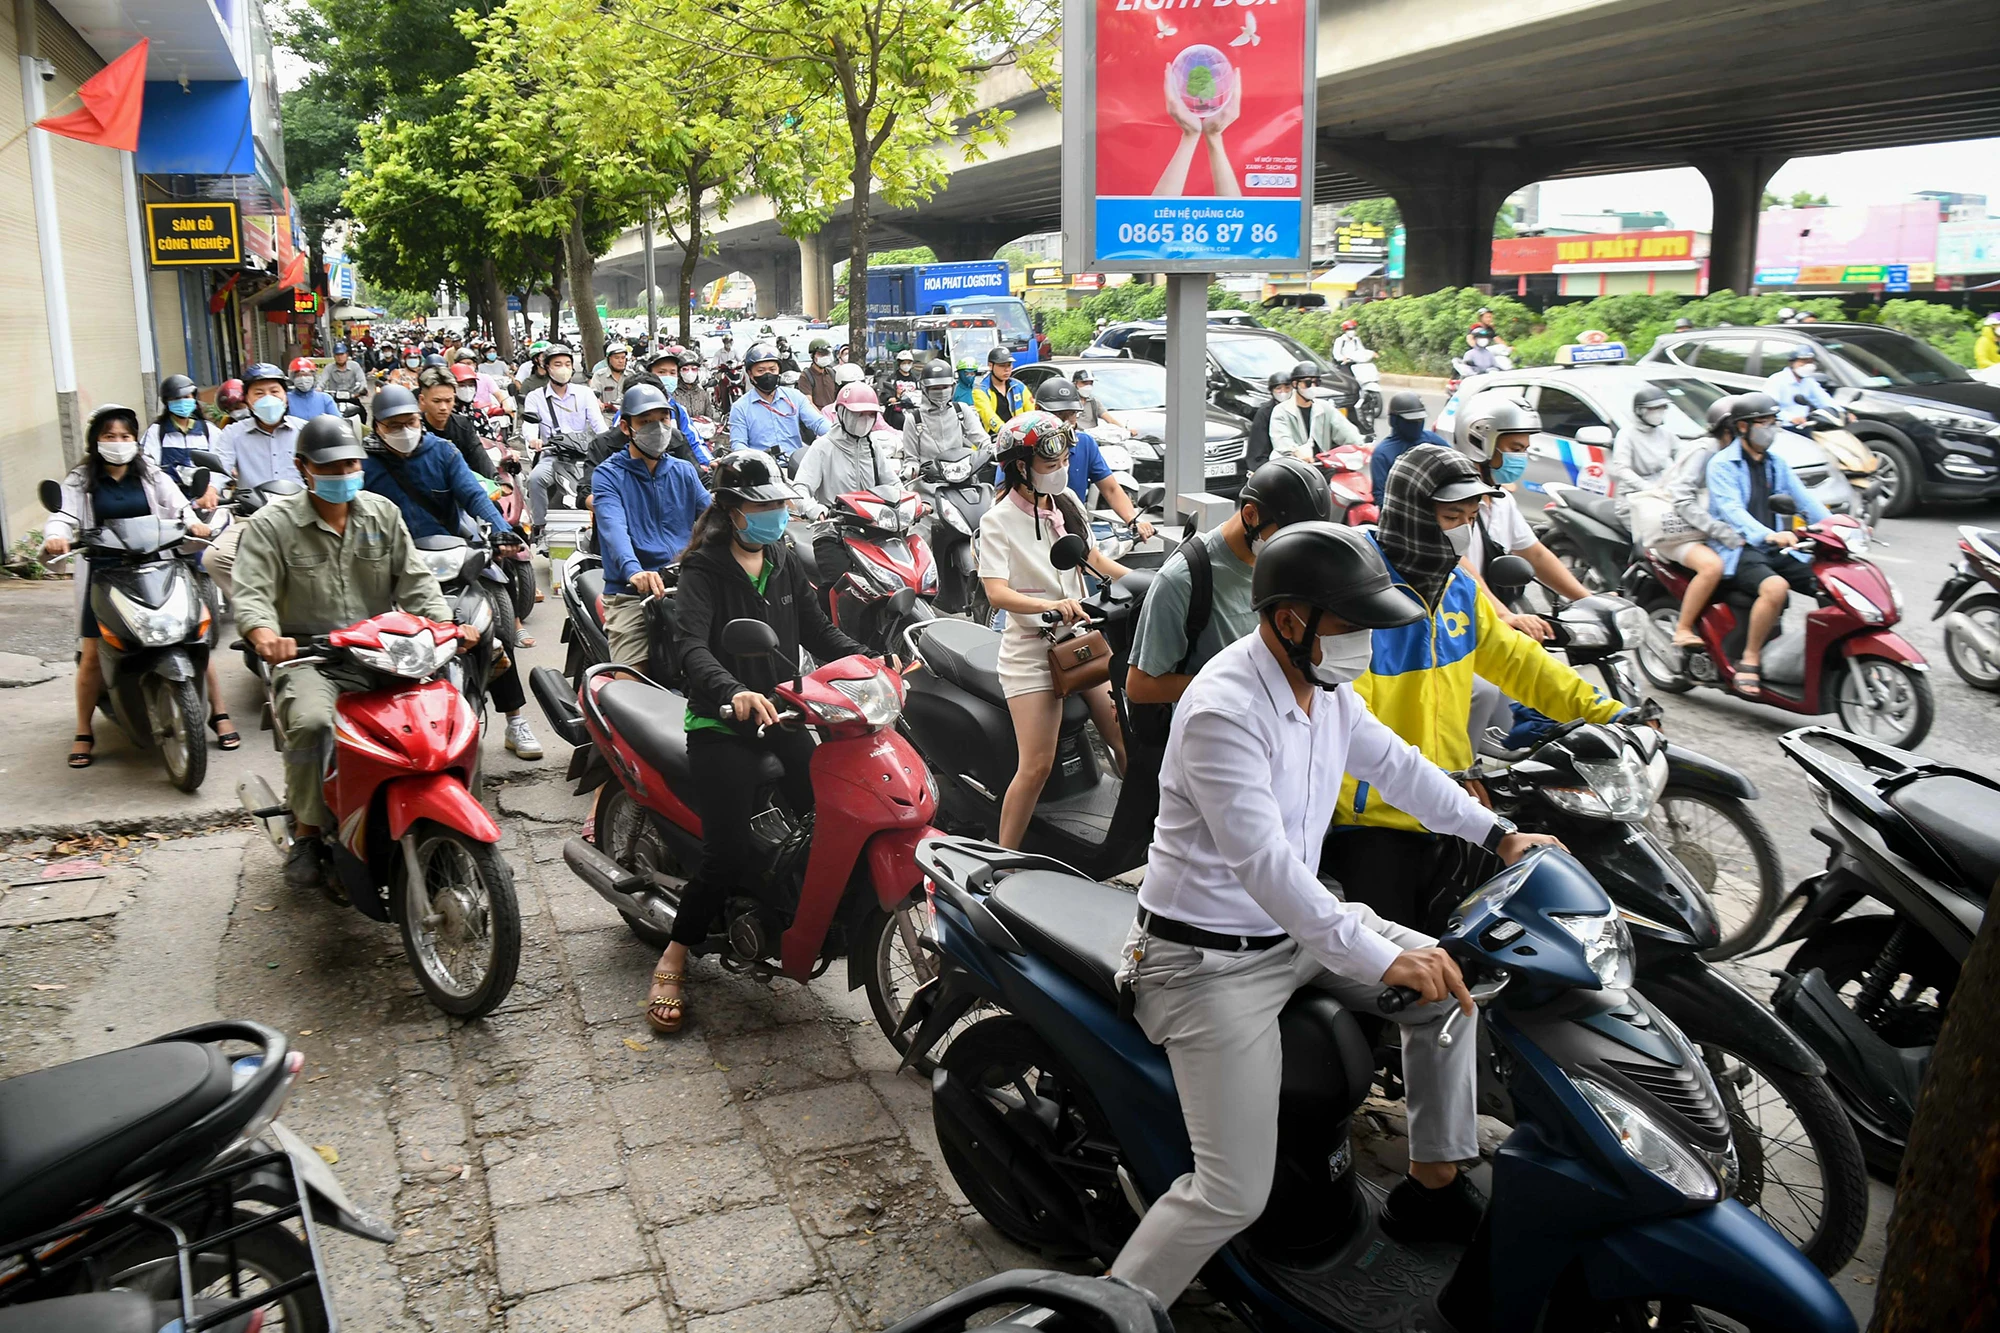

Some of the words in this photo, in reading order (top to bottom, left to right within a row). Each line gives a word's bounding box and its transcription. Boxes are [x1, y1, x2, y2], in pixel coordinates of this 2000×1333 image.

[1154, 207, 1176, 219] LIÊN
[1177, 207, 1190, 220] HỆ
[1225, 207, 1244, 219] CÁO
[172, 216, 197, 231] SÀN
[1118, 223, 1174, 244] 0865
[1181, 223, 1209, 243] 86
[1216, 223, 1244, 243] 87
[1251, 223, 1278, 243] 86
[157, 236, 189, 250] CÔNG
[190, 235, 231, 252] NGHIỆP
[1592, 235, 1639, 259] PHÁT
[1639, 236, 1689, 258] AUTO
[924, 278, 941, 291] HOA
[942, 276, 962, 289] PHAT
[962, 274, 1002, 288] LOGISTICS
